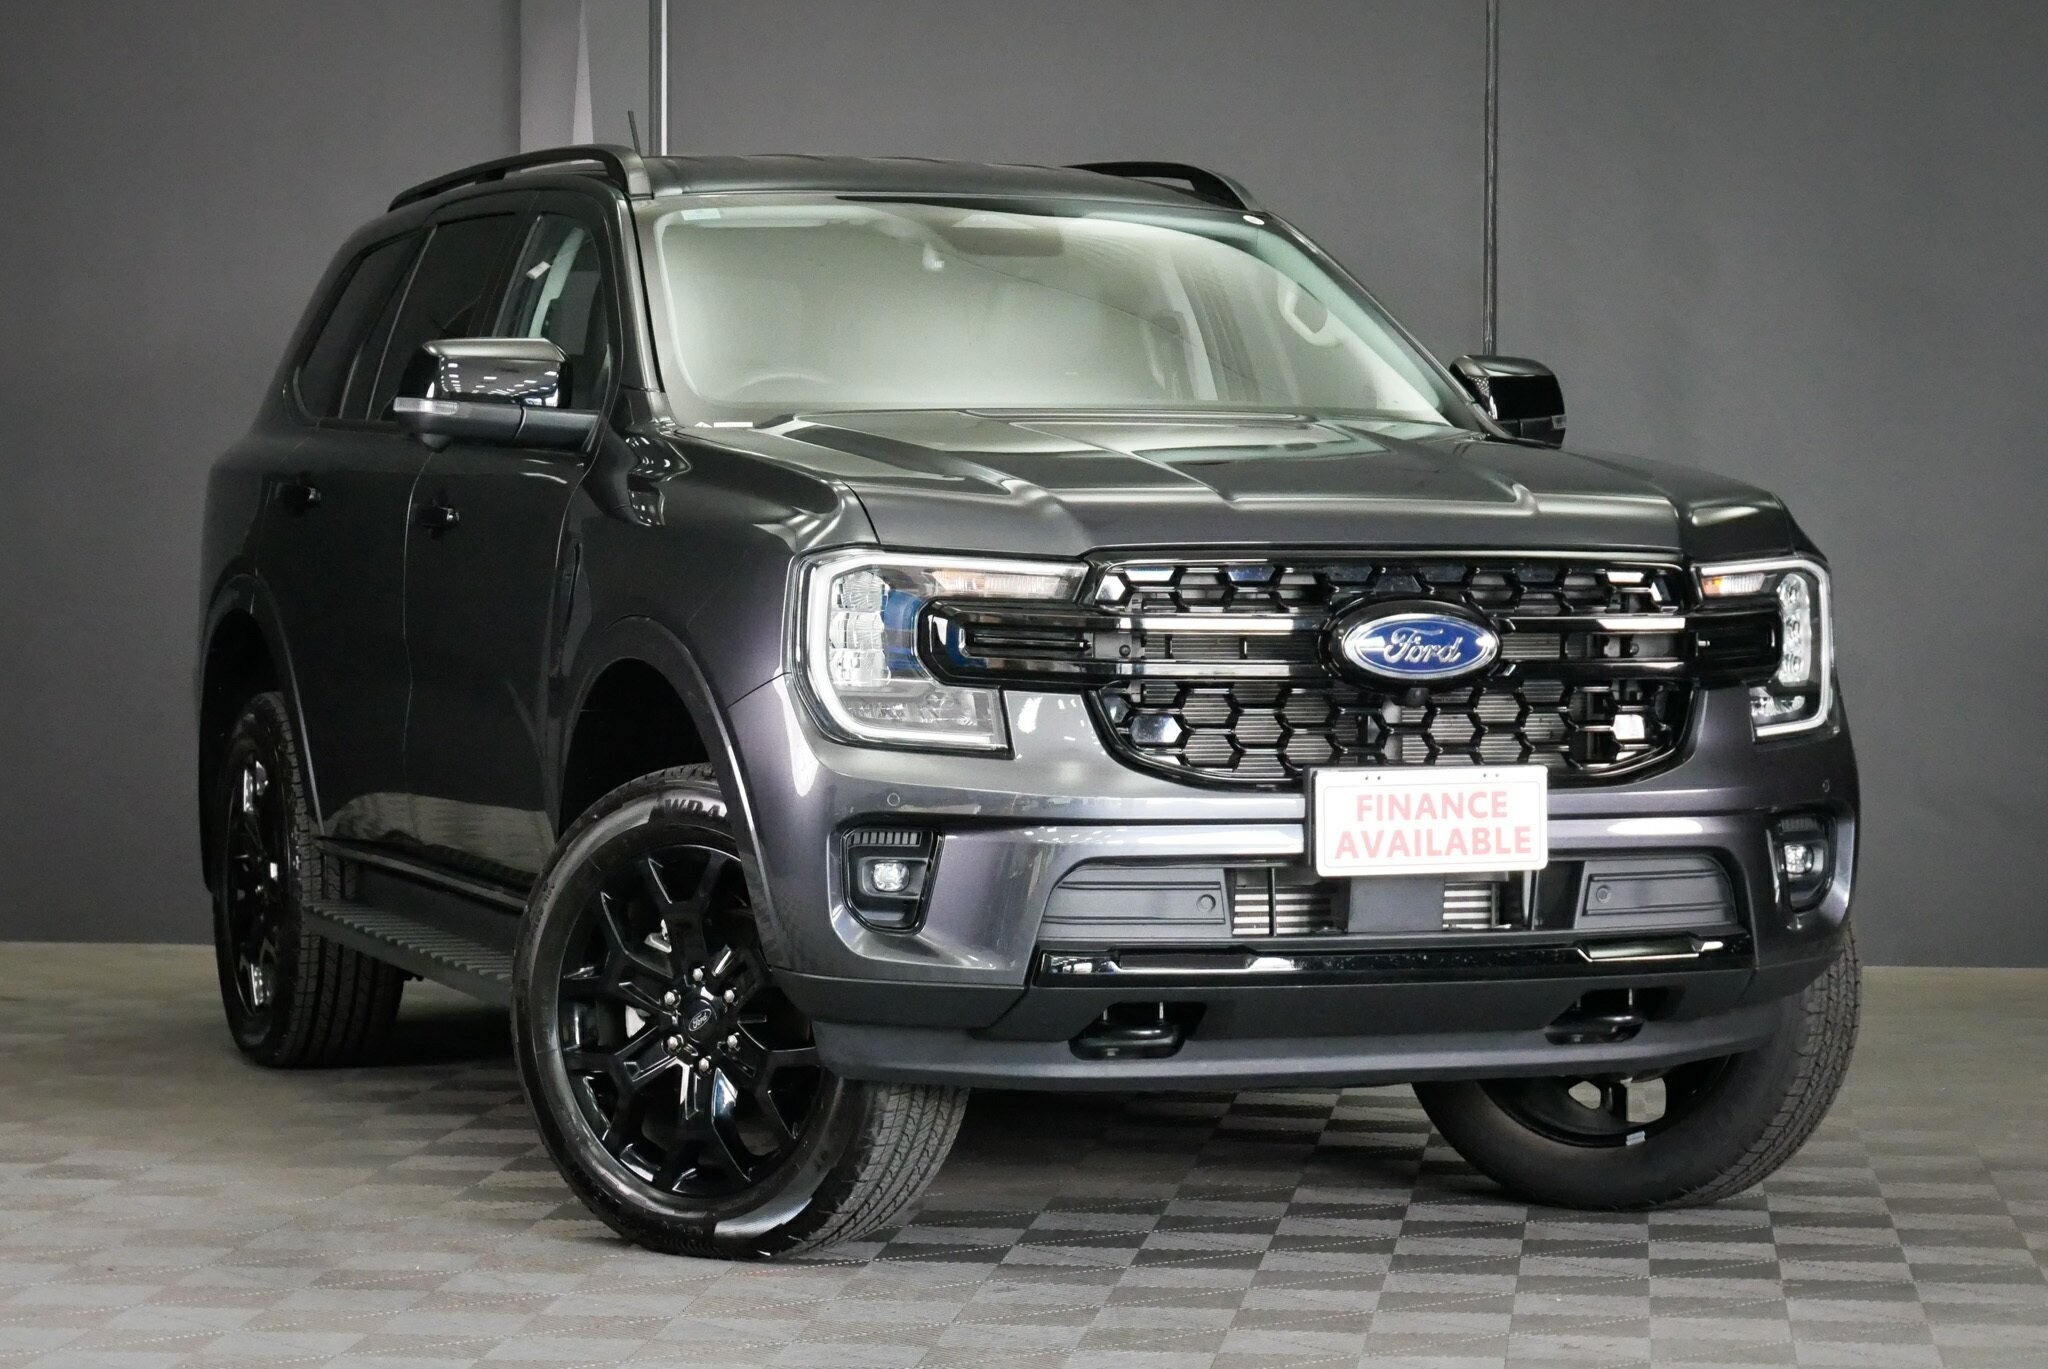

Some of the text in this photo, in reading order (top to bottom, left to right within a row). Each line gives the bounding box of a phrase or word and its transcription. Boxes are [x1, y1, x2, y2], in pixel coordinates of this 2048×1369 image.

[1384, 627, 1463, 663] Ford
[1356, 791, 1508, 822] FINANCE
[1334, 826, 1532, 859] AVAILABLE
[692, 1011, 708, 1029] Ford
